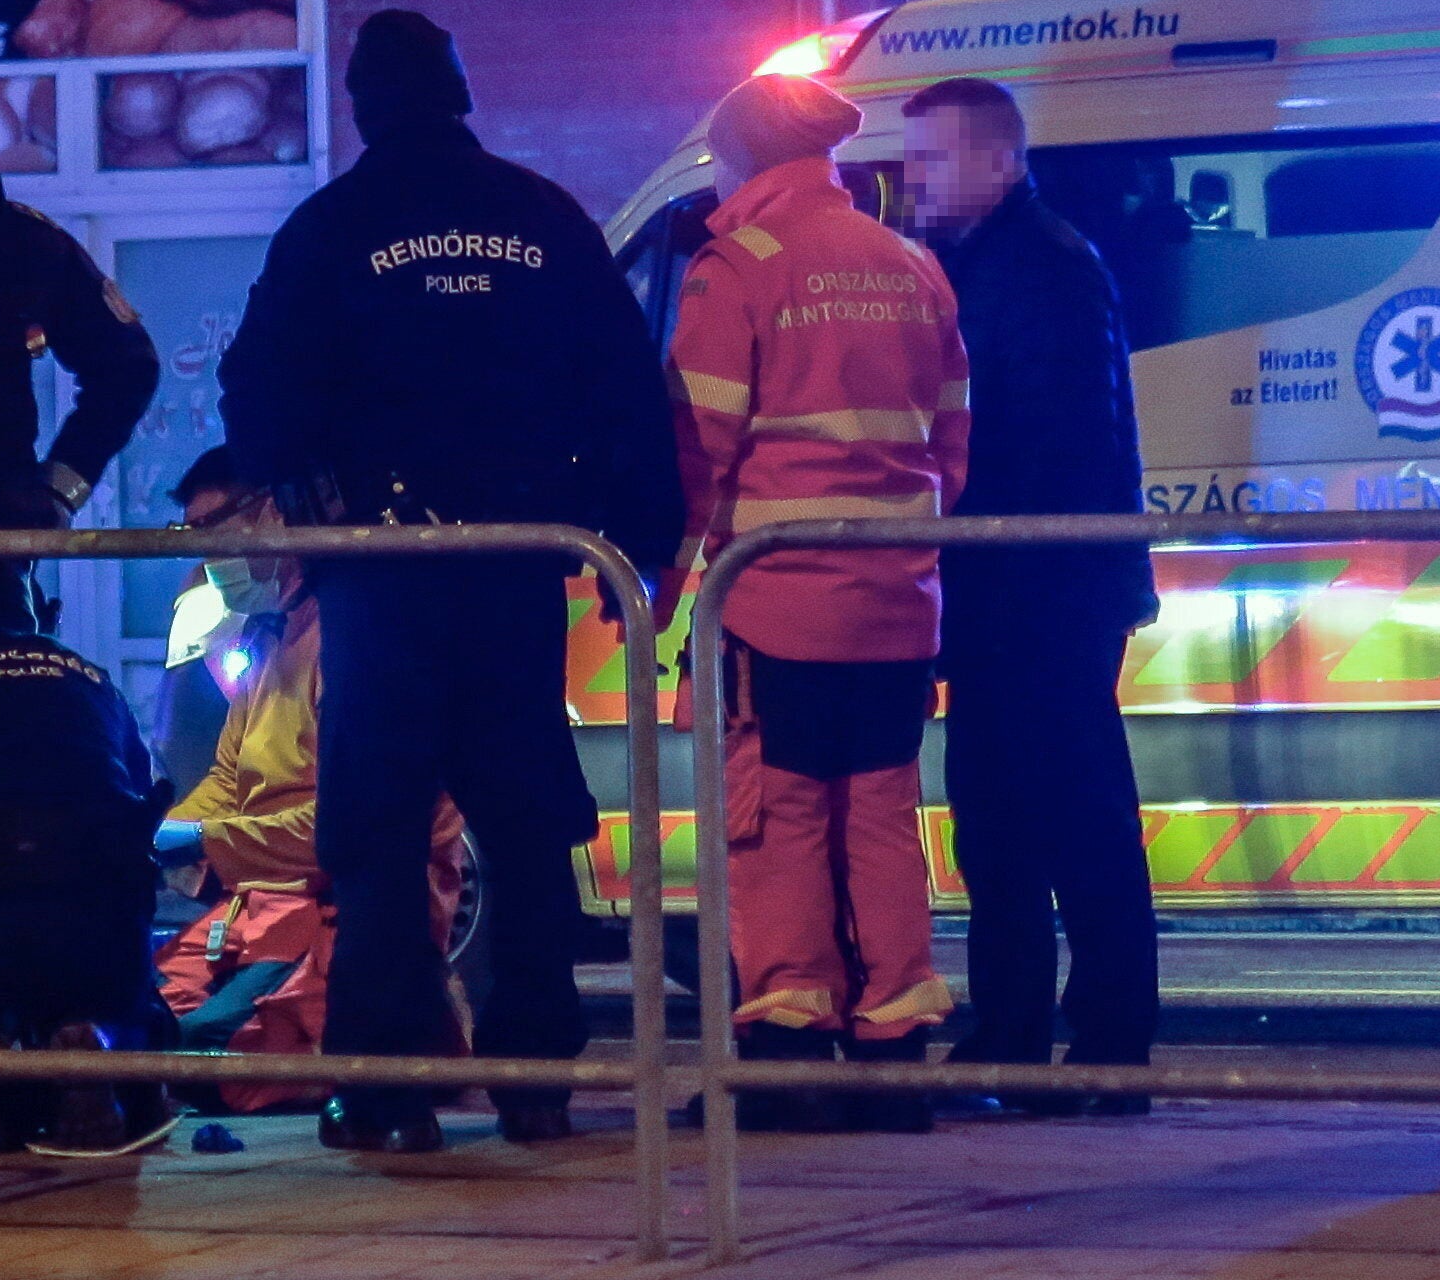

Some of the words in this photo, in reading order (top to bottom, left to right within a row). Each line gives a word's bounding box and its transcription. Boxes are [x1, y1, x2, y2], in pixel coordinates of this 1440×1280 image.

[879, 7, 1180, 55] www.mentok.hu
[370, 228, 543, 275] RENDŐRSÉG
[425, 274, 492, 293] POLICE
[1258, 348, 1337, 371] Hivatás
[1230, 386, 1254, 406] az
